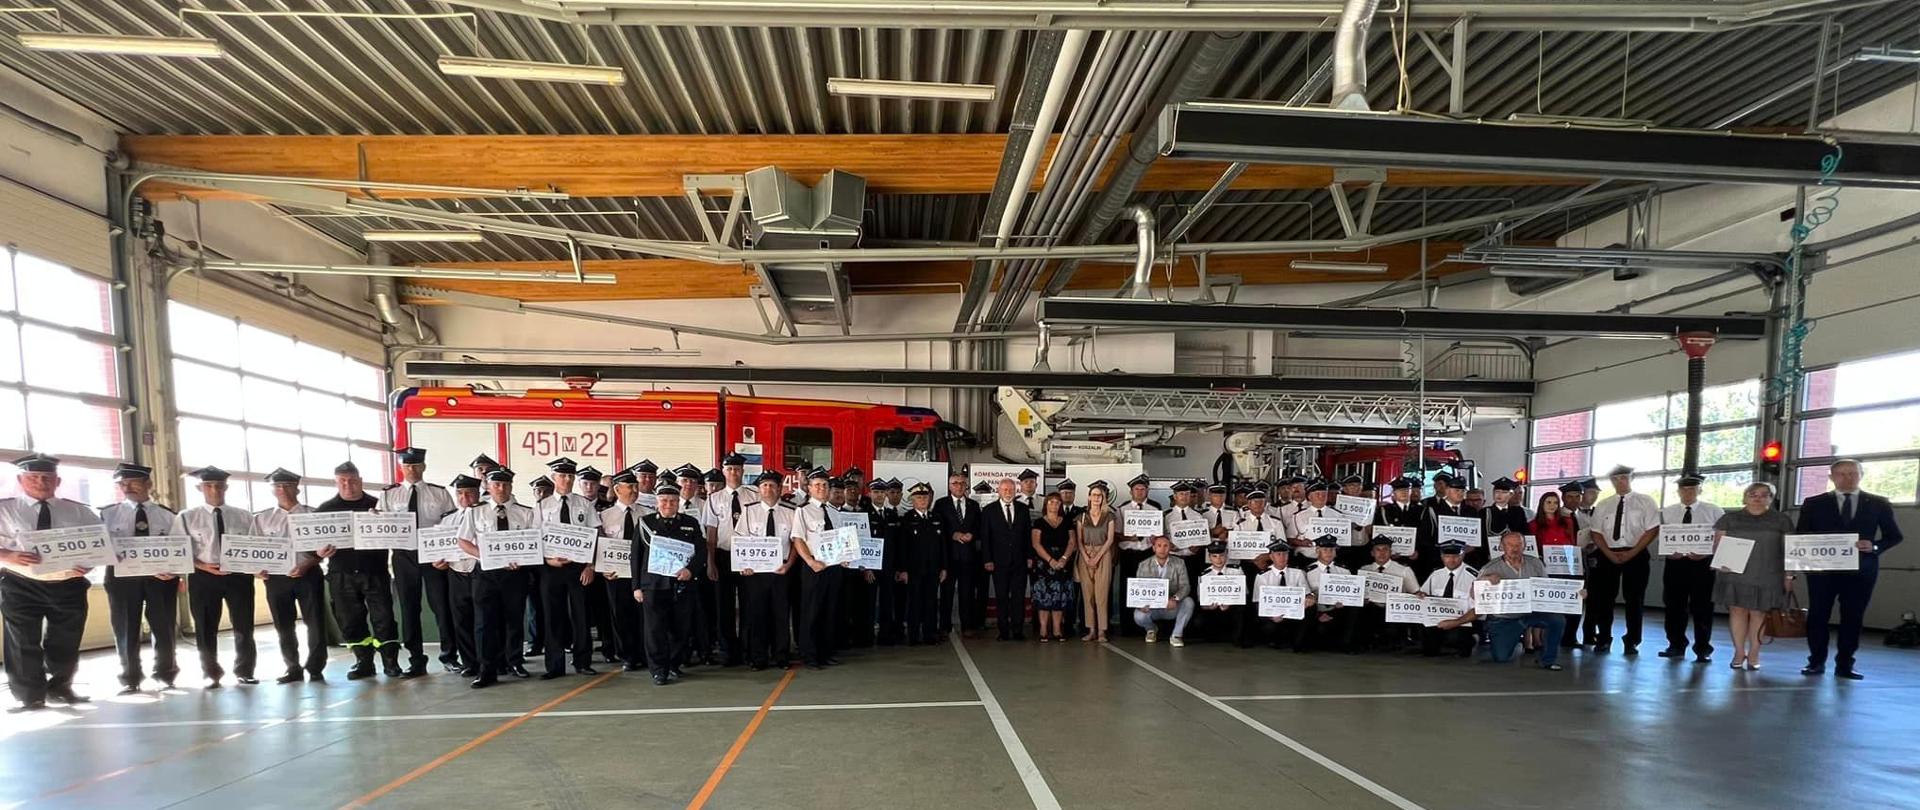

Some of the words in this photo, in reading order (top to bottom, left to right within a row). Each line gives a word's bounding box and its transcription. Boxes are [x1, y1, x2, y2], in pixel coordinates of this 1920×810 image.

[522, 431, 558, 456] 451
[563, 437, 576, 451] M
[580, 432, 608, 456] 22
[783, 474, 800, 492] 45
[296, 527, 310, 536] 13
[315, 526, 336, 534] 500
[341, 525, 351, 533] zł
[360, 525, 372, 534] 13
[377, 524, 398, 533] 500
[401, 525, 411, 533] zł
[423, 539, 435, 548] 14
[542, 534, 561, 544] 475
[563, 536, 581, 547] 000
[32, 542, 52, 554] 13
[58, 540, 86, 552] 500
[505, 542, 525, 550] 960
[121, 550, 138, 559] 13
[143, 548, 169, 558] 500
[225, 549, 248, 559] 475
[252, 549, 274, 560] 000
[603, 551, 613, 559] 14
[750, 549, 766, 557] 976
[861, 548, 874, 556] 000
[1789, 548, 1806, 557] 40
[1811, 547, 1836, 556] 000
[1370, 582, 1388, 590] 000
[1142, 588, 1156, 597] 010
